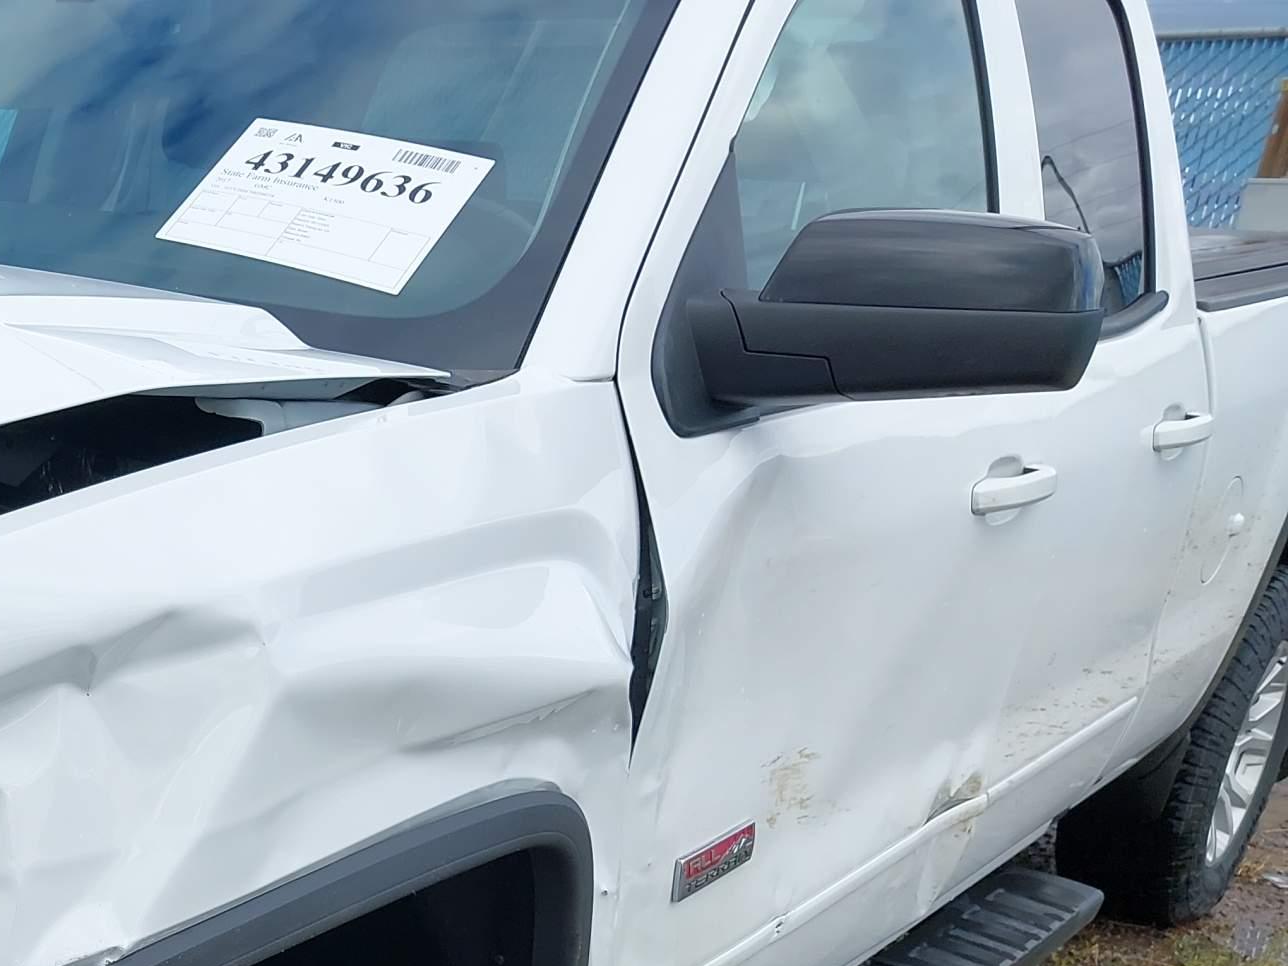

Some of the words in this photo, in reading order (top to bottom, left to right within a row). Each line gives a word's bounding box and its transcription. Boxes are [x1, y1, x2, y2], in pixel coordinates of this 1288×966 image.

[220, 168, 245, 178] State
[246, 171, 272, 183] Farm
[272, 176, 320, 192] Insurance
[245, 150, 442, 204] 43149636
